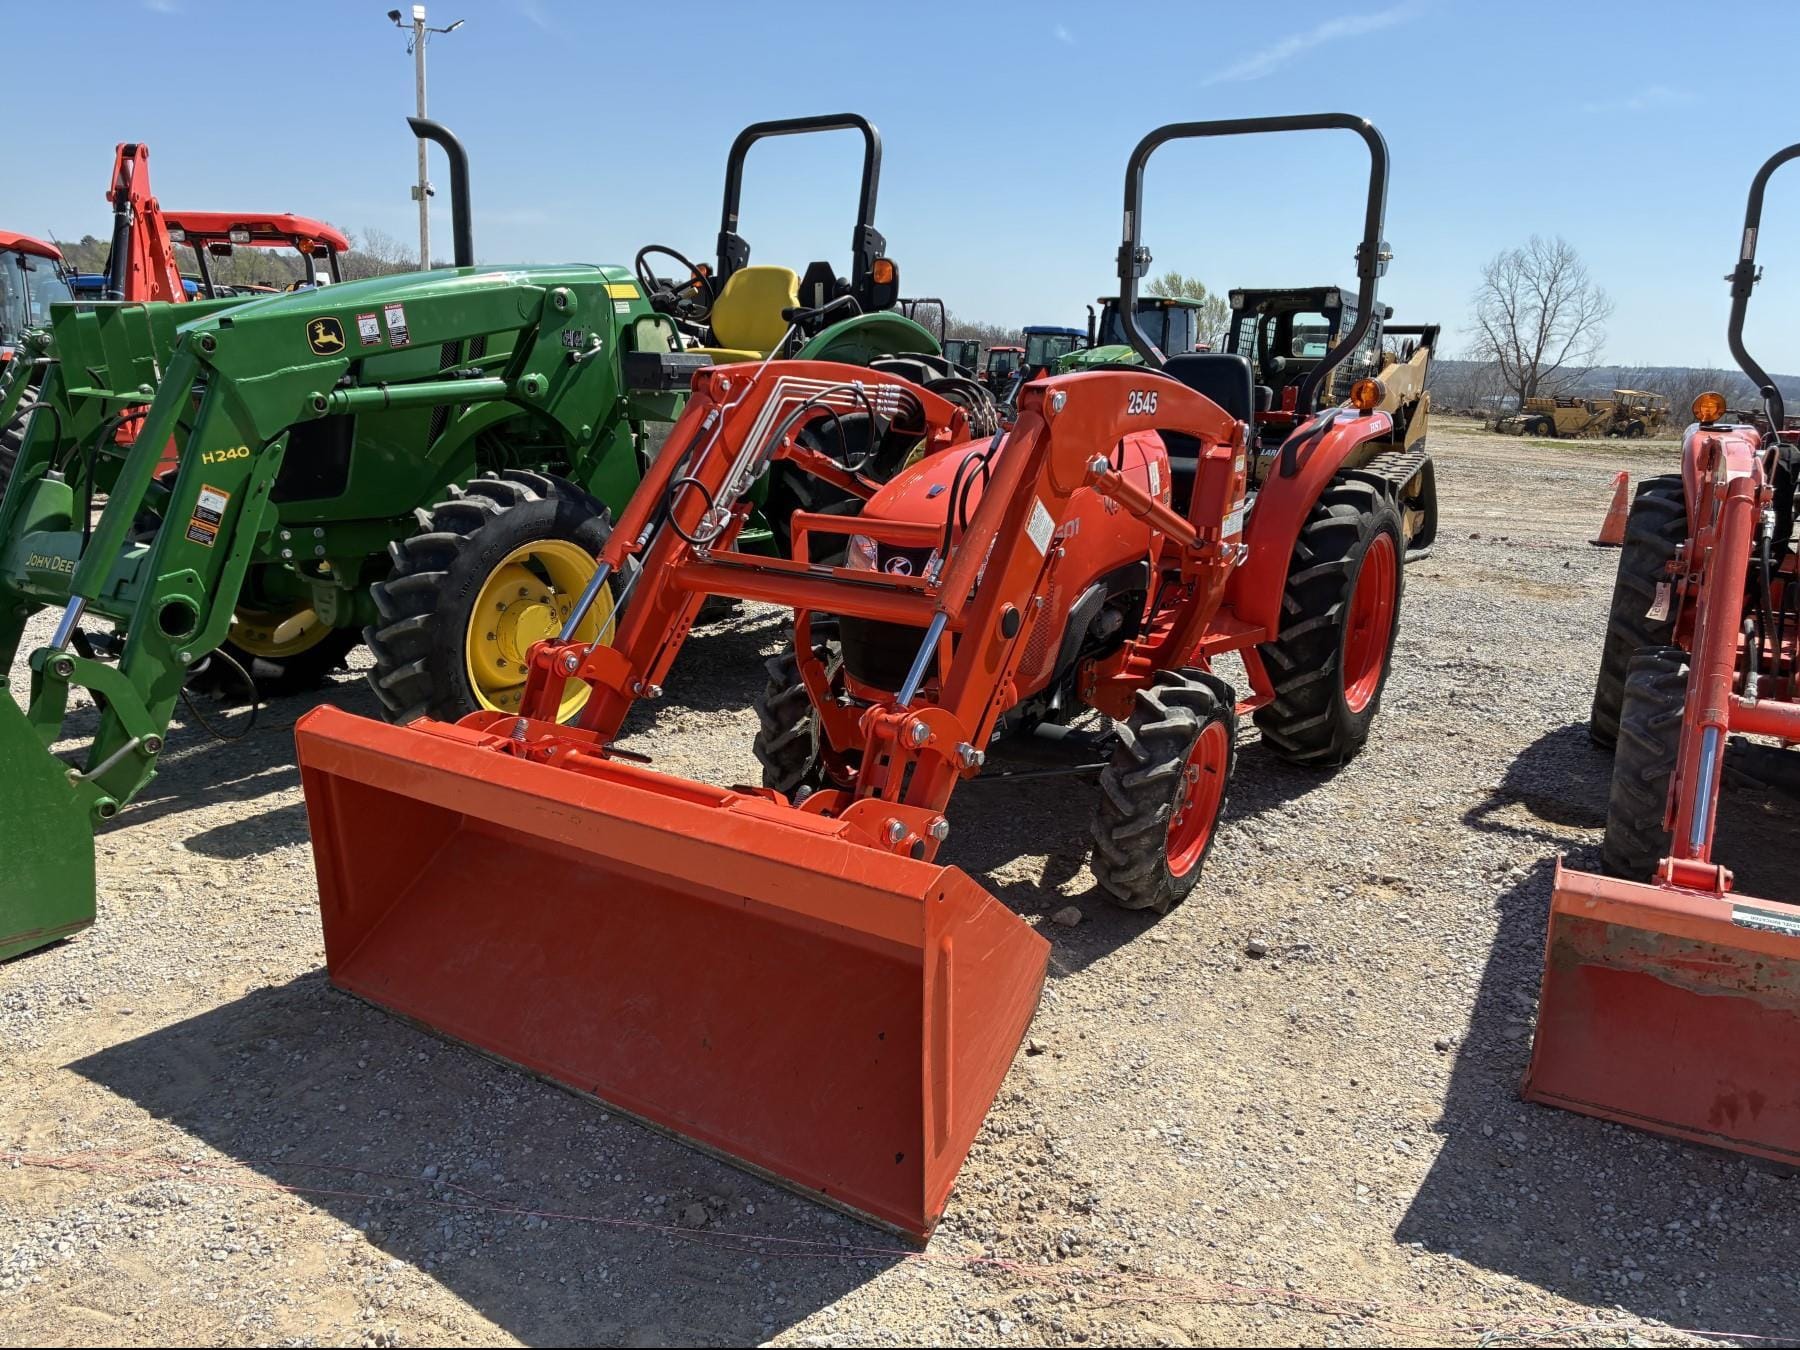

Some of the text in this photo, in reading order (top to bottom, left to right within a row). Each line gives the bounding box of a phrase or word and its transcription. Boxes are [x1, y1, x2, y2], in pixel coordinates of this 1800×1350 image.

[1127, 390, 1158, 415] 2545
[202, 445, 250, 465] H240
[25, 552, 51, 568] JOHN
